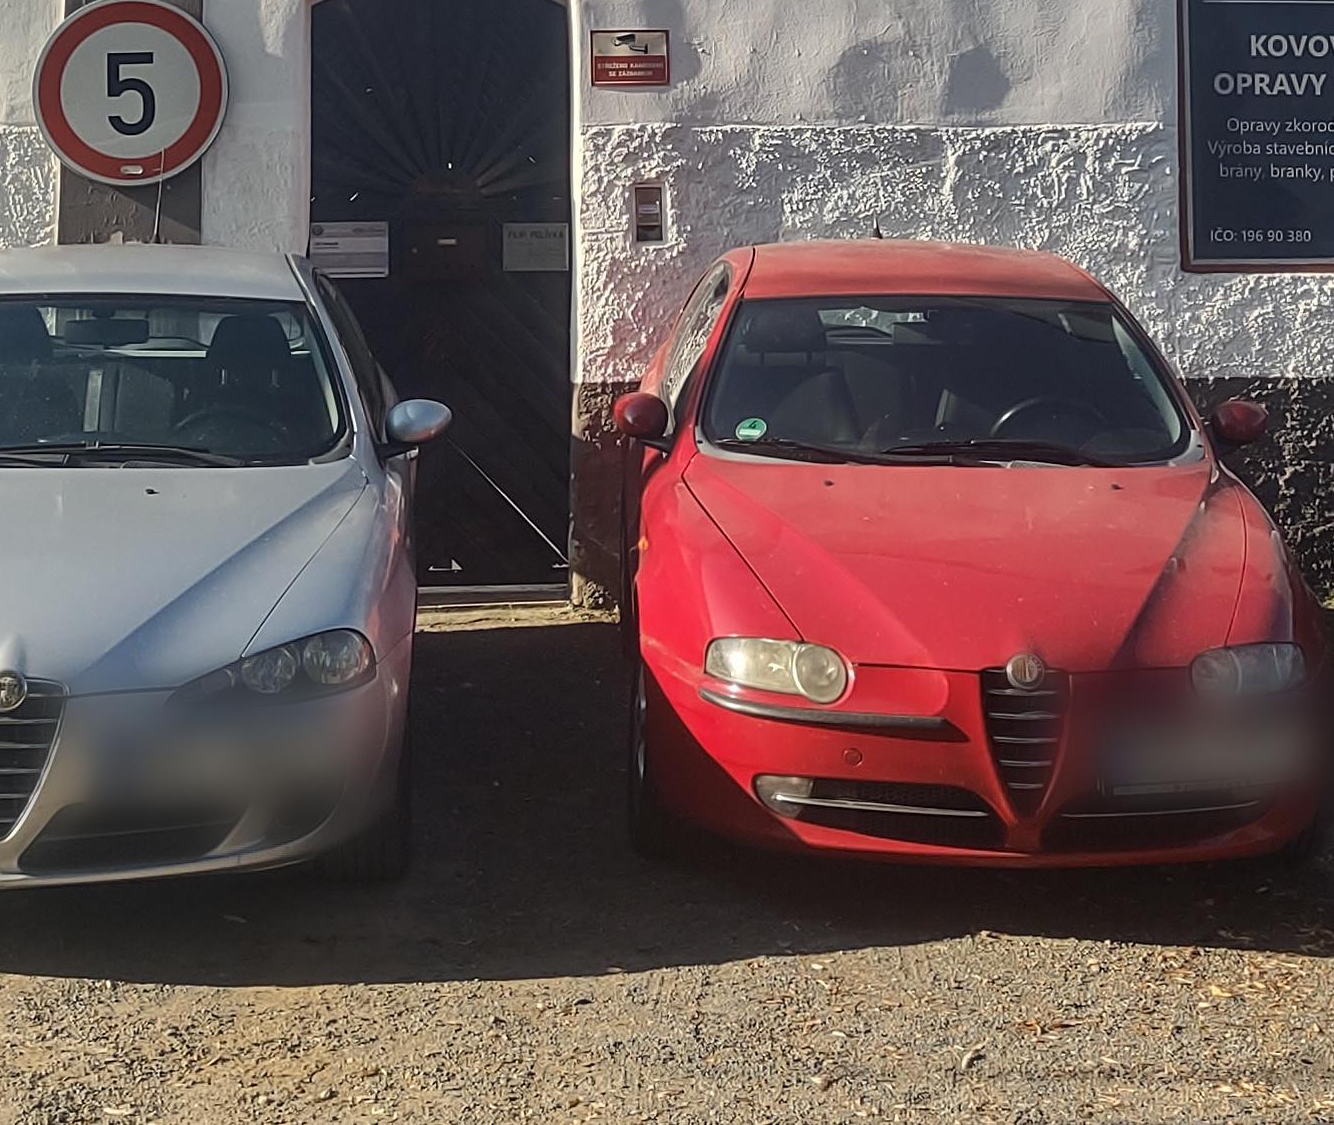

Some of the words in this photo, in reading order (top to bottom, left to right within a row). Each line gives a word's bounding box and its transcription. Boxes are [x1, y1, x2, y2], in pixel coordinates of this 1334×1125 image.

[107, 51, 156, 136] 5
[1214, 73, 1327, 95] OPRAVY
[1226, 117, 1281, 136] Opravy
[1207, 139, 1261, 158] Výroba
[1270, 163, 1325, 182] branky,
[1210, 226, 1238, 243] IČO:
[1242, 230, 1264, 243] 196
[1267, 230, 1284, 243] 90
[1287, 230, 1312, 243] 380
